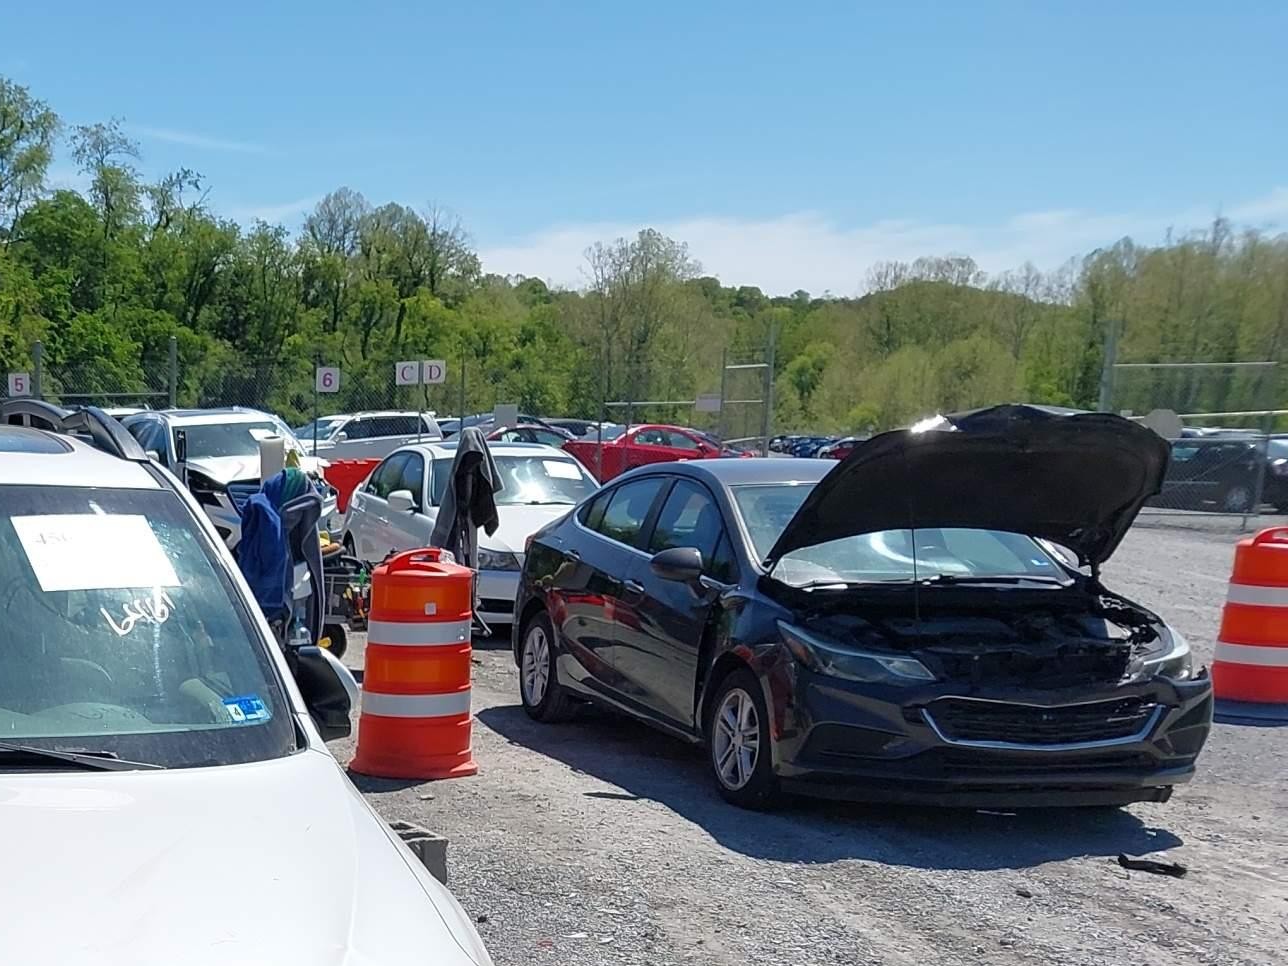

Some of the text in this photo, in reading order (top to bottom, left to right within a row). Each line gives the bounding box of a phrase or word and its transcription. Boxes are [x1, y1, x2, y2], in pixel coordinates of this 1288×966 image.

[322, 372, 333, 388] 6
[401, 365, 414, 381] C
[428, 365, 442, 381] D
[14, 377, 24, 393] 5
